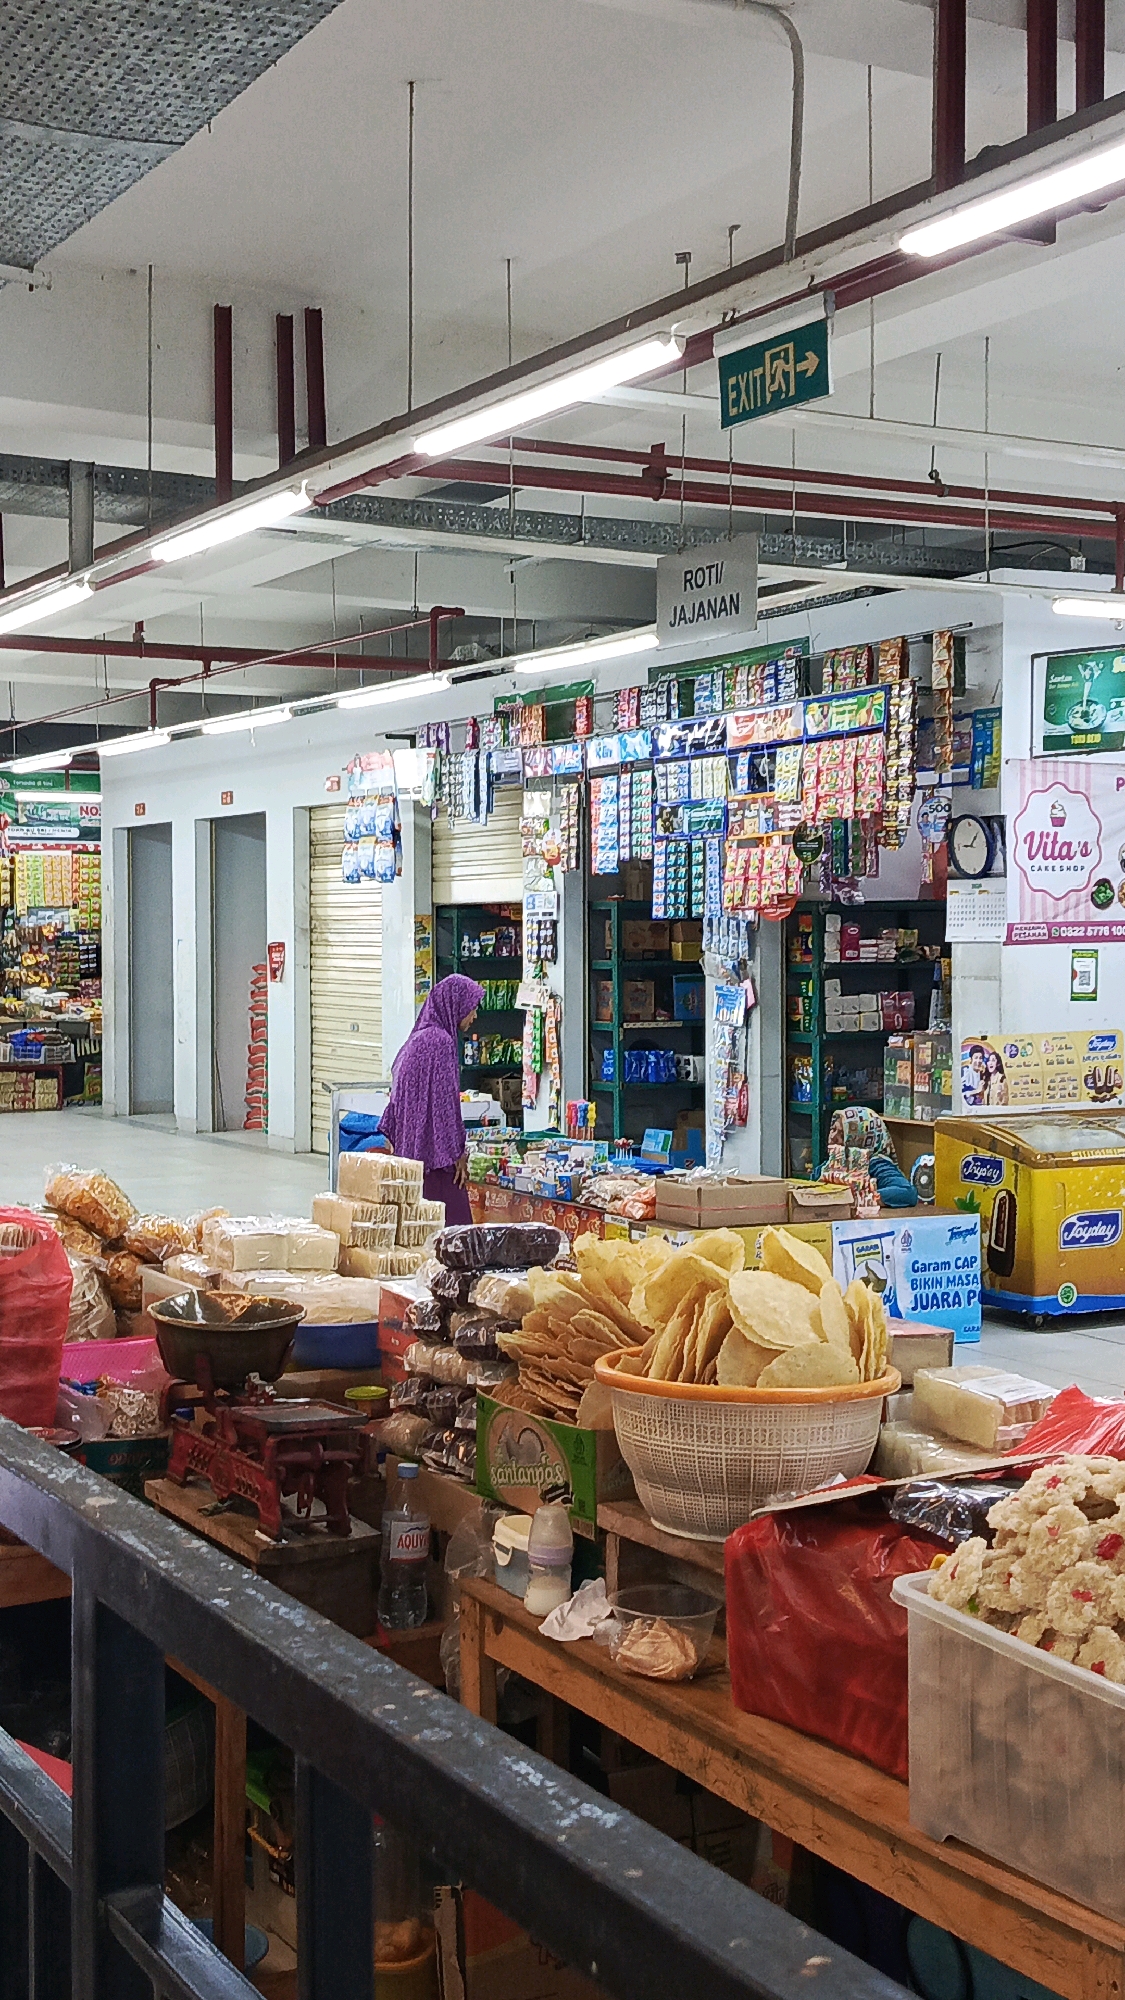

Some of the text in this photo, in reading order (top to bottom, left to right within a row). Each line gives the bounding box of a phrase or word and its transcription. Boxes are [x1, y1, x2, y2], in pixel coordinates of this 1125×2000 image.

[728, 369, 764, 417] EXIT
[683, 560, 724, 591] ROTI/
[669, 592, 741, 628] JAJANAN
[929, 803, 952, 813] 500
[1023, 830, 1093, 861] Vita's
[1064, 1220, 1117, 1243] Joyday
[911, 1255, 978, 1273] Garam CAP
[910, 1273, 979, 1291] BIKIN MASA
[911, 1291, 962, 1312] JUARA
